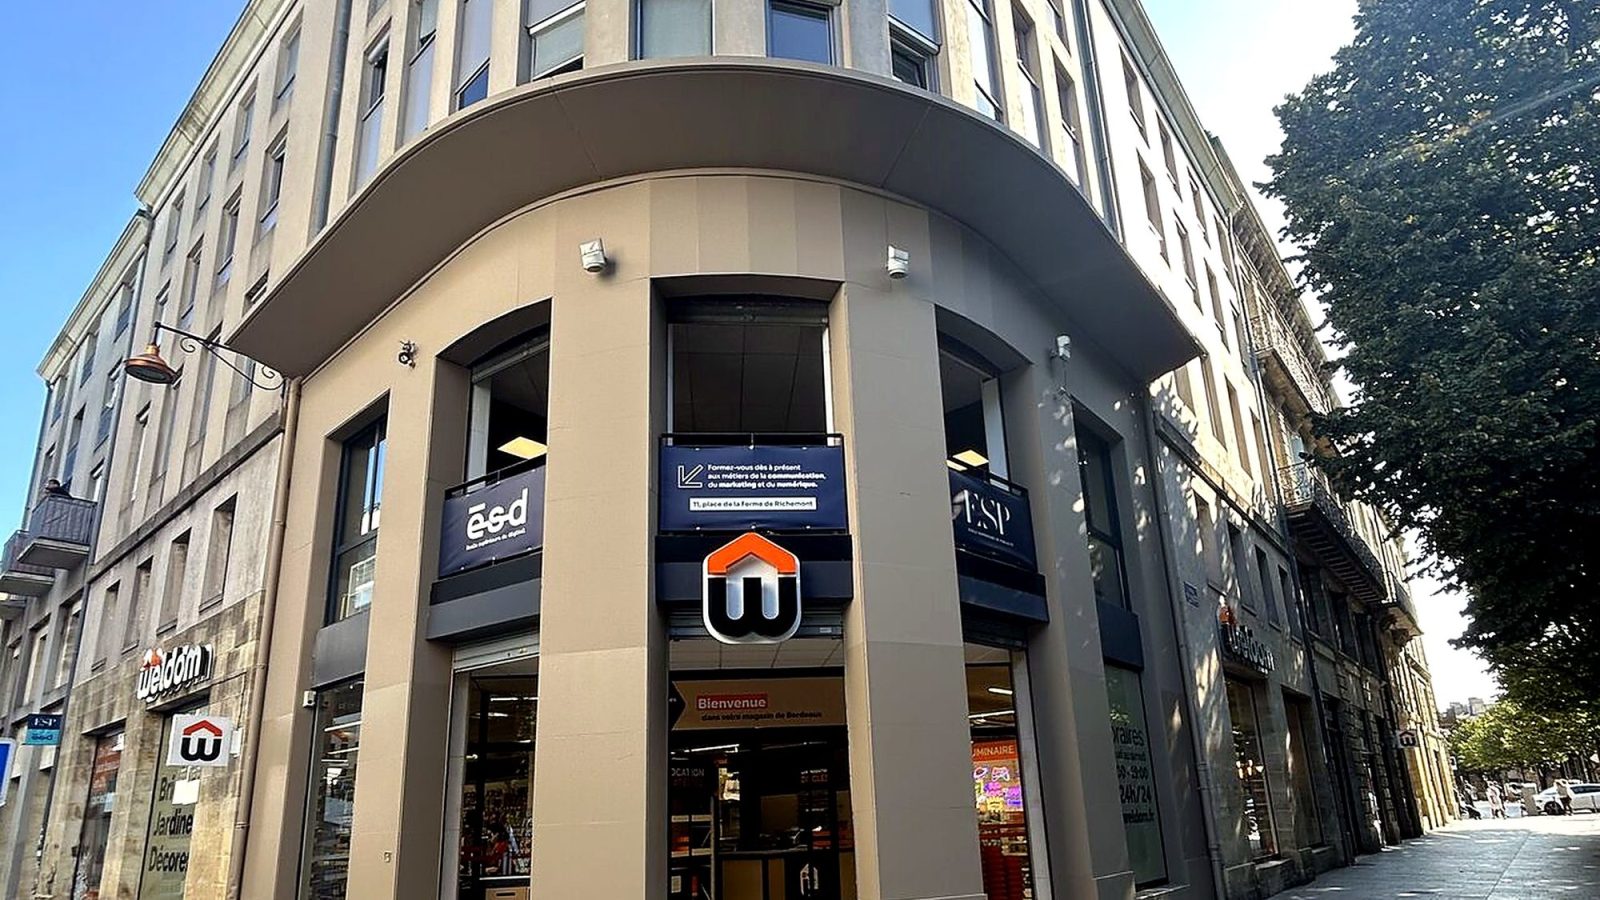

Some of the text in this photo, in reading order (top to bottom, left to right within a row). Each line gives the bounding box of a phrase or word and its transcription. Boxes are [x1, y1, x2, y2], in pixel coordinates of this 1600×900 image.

[774, 464, 801, 472] présent
[721, 472, 749, 480] métiers
[718, 481, 757, 490] marketing
[137, 644, 209, 699] weldom
[698, 698, 767, 709] Bienvenue
[774, 711, 786, 719] de
